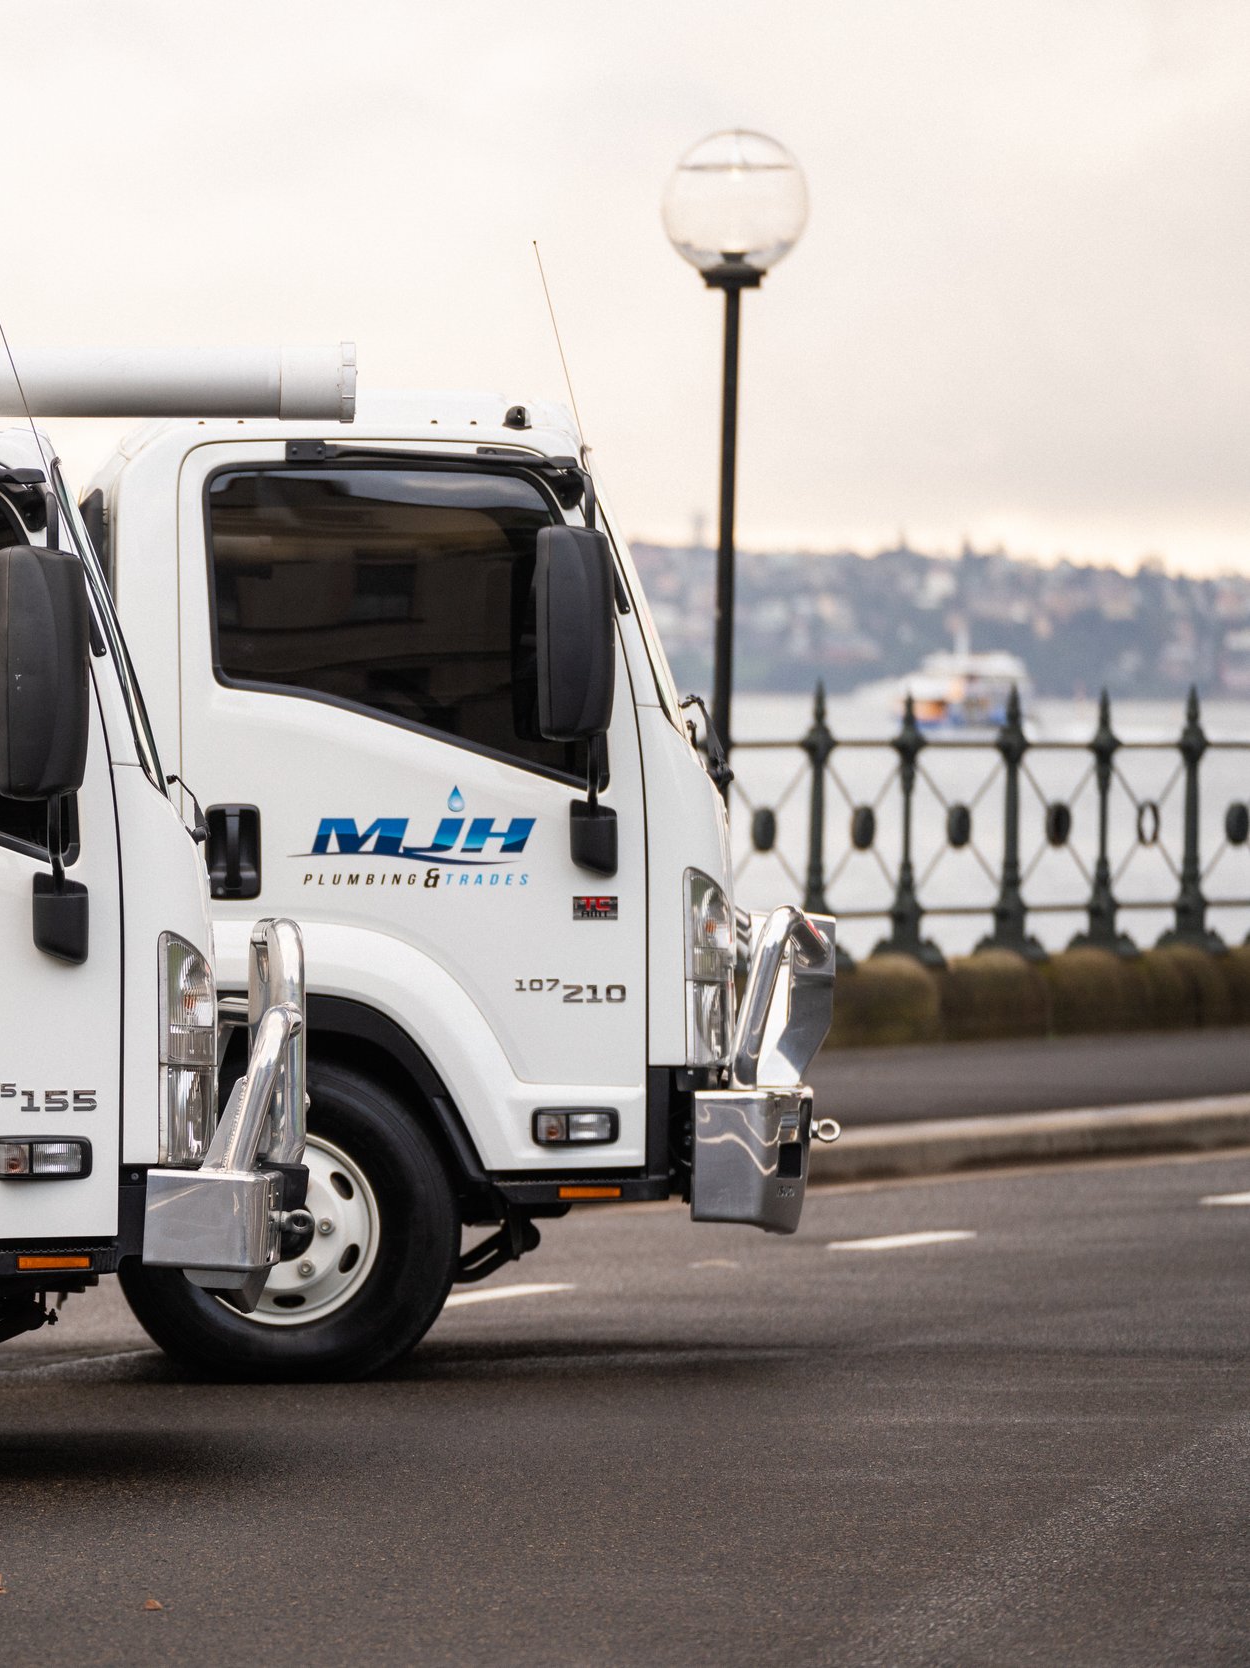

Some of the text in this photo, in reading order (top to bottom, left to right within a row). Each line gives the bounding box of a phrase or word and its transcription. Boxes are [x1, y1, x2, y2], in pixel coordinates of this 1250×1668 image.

[311, 818, 537, 853] MJH
[304, 868, 528, 888] PLUMBING & TRADES
[515, 979, 626, 1003] 107 210
[21, 1090, 98, 1112] 155
